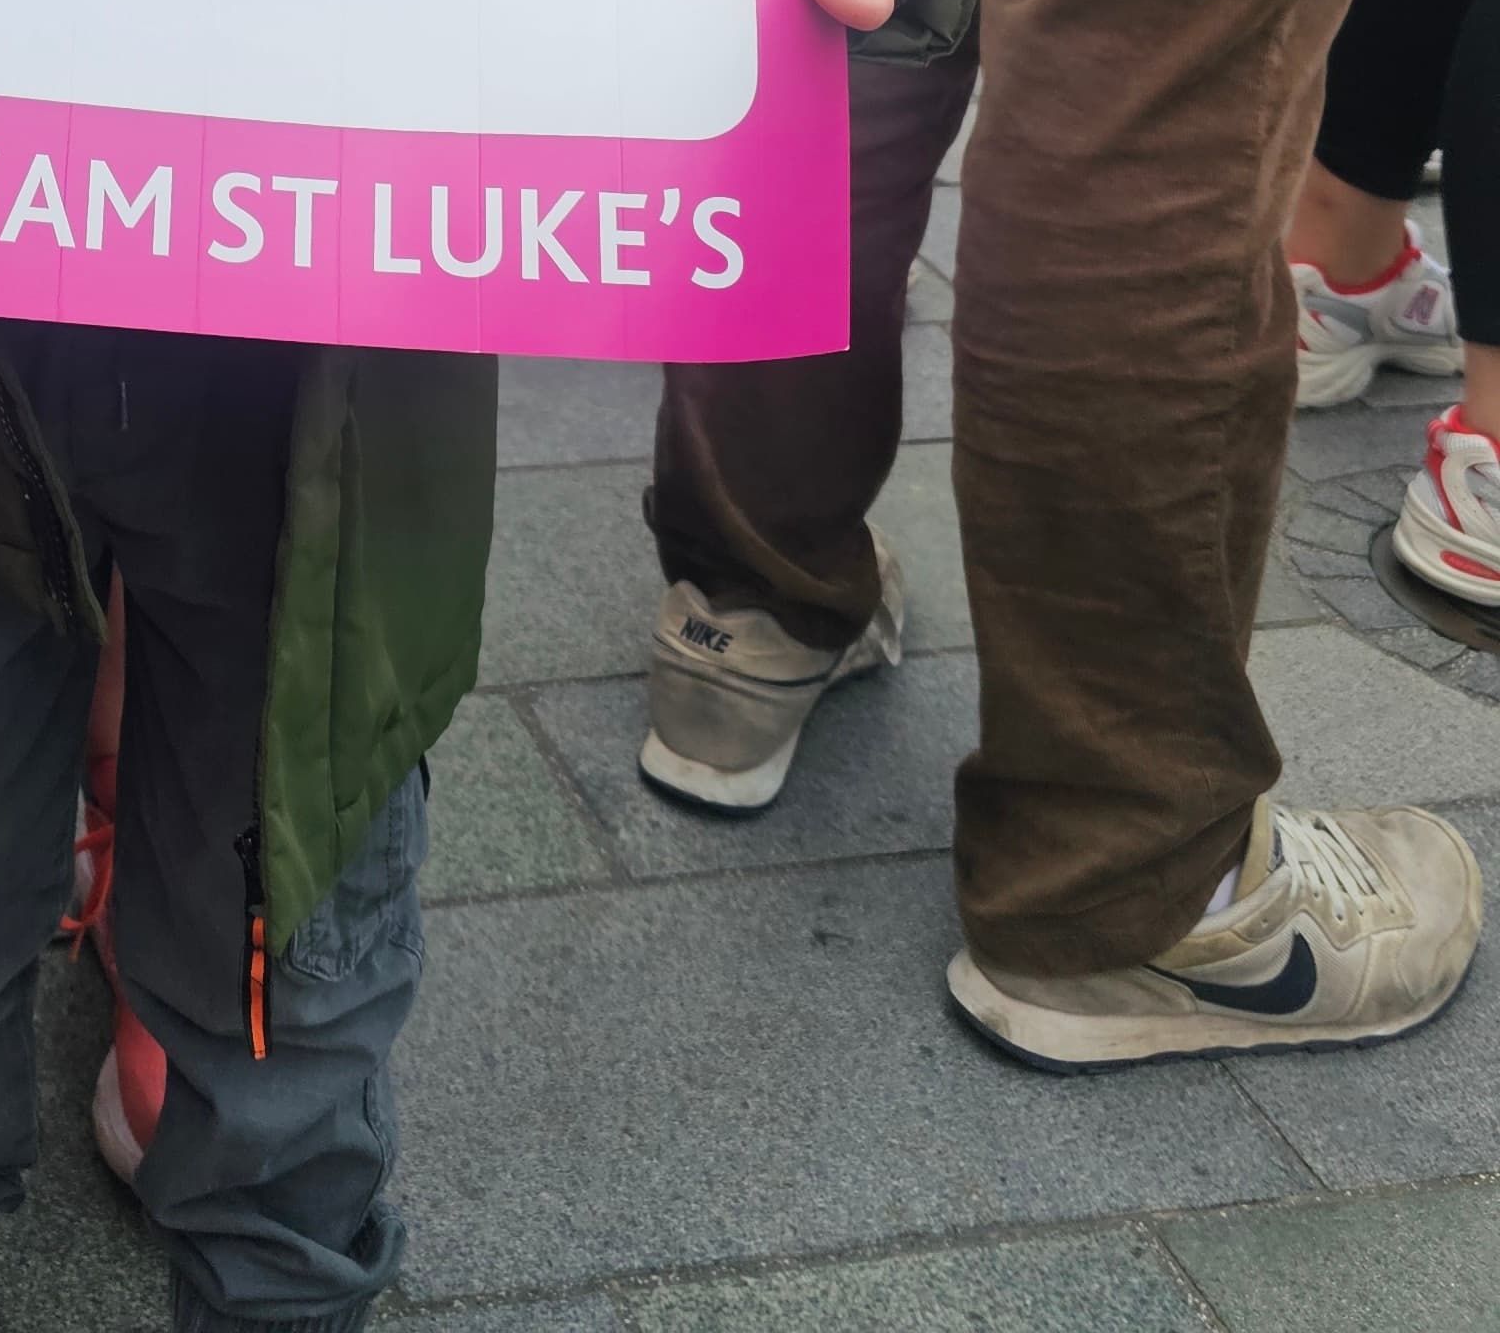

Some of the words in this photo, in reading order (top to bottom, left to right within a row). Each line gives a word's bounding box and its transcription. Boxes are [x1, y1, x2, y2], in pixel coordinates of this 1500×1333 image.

[206, 171, 339, 269] ST
[372, 182, 746, 289] LUKE'S
[680, 616, 734, 654] NIKE
